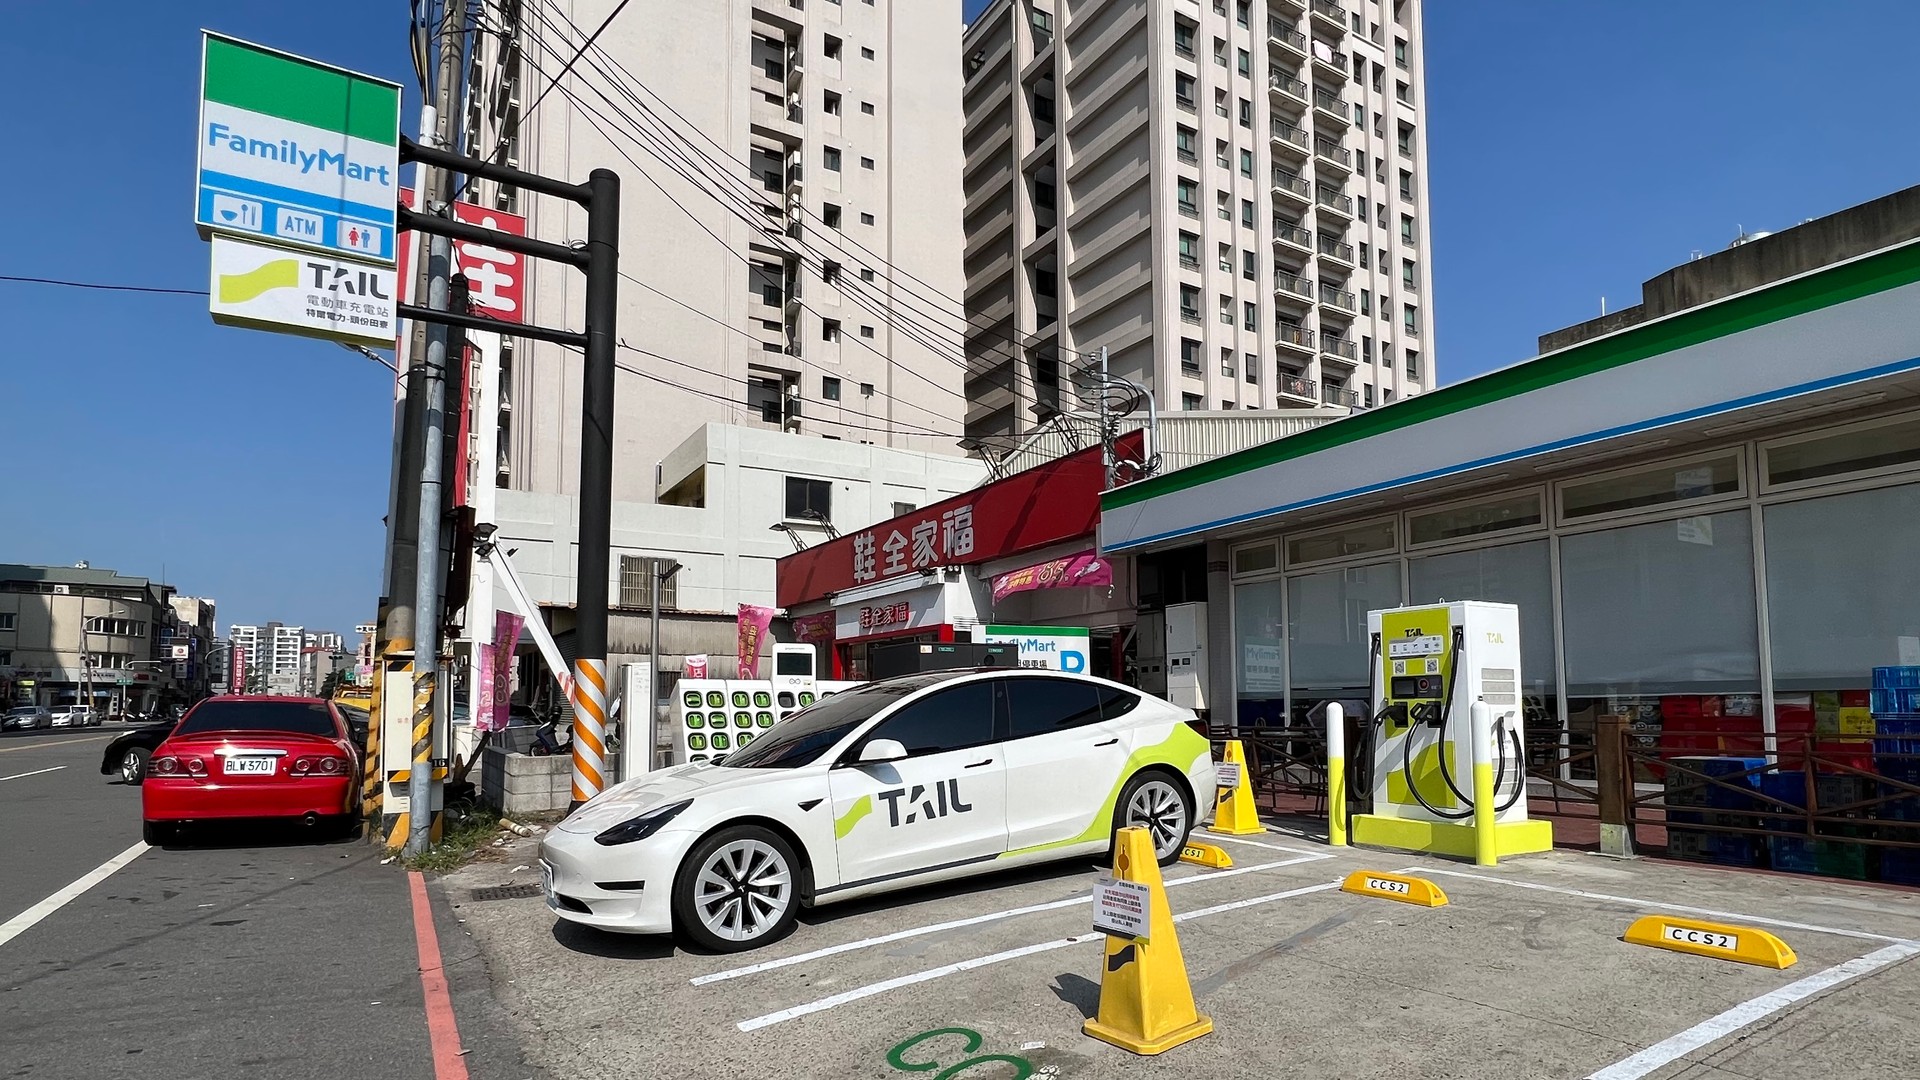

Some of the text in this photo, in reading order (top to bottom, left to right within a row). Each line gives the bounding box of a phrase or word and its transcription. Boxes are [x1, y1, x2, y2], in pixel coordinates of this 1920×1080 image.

[208, 122, 390, 186] FamilyMart
[284, 215, 317, 236] ATM
[307, 262, 389, 300] TAIL
[306, 294, 389, 318] 電動車充電站
[853, 504, 974, 584] 鞋全家福
[860, 601, 908, 628] 鞋全家福
[1404, 628, 1425, 638] TAIL
[1486, 633, 1504, 644] TAIL
[877, 778, 973, 828] TAIL
[1181, 848, 1201, 858] CS1
[1370, 879, 1404, 893] CCS2
[1672, 928, 1728, 948] CCS2
